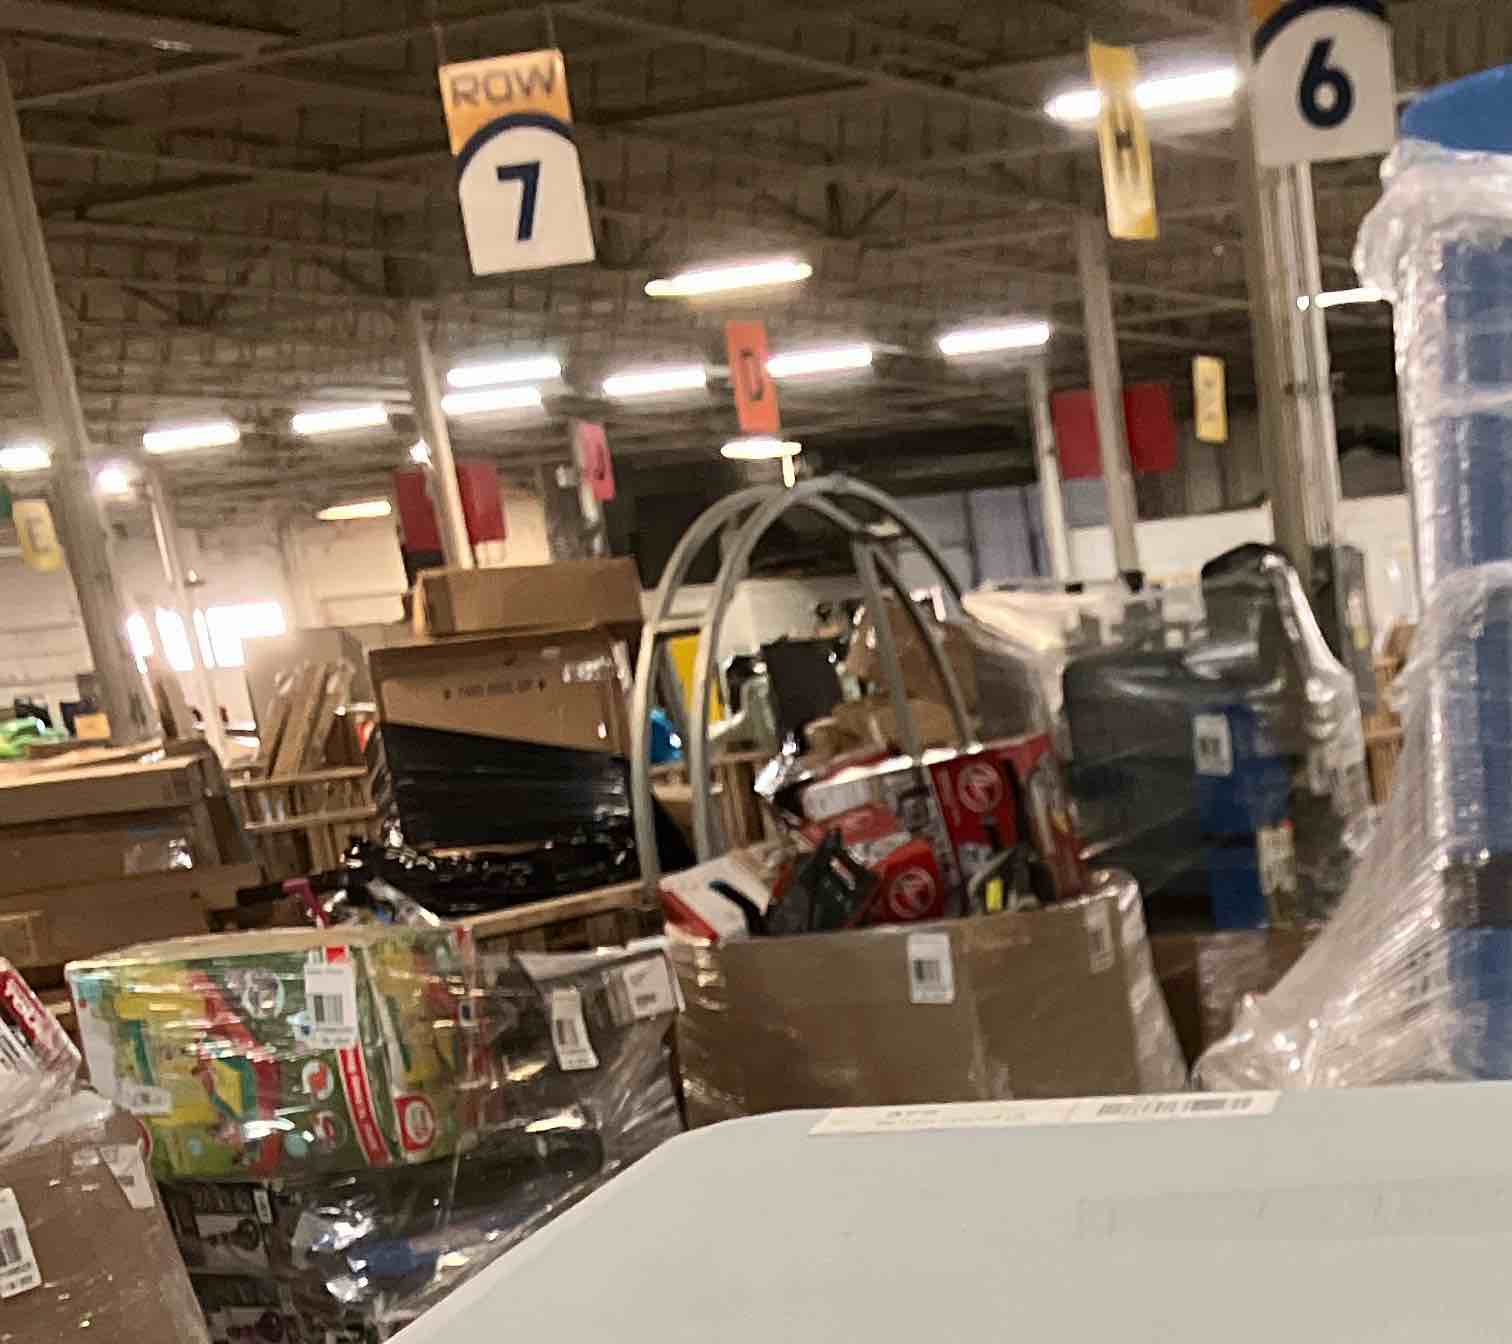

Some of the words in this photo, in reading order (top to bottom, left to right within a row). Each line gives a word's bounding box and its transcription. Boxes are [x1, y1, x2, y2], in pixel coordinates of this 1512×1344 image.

[450, 66, 558, 108] ROW
[1298, 36, 1353, 129] 6
[495, 160, 541, 242] 7
